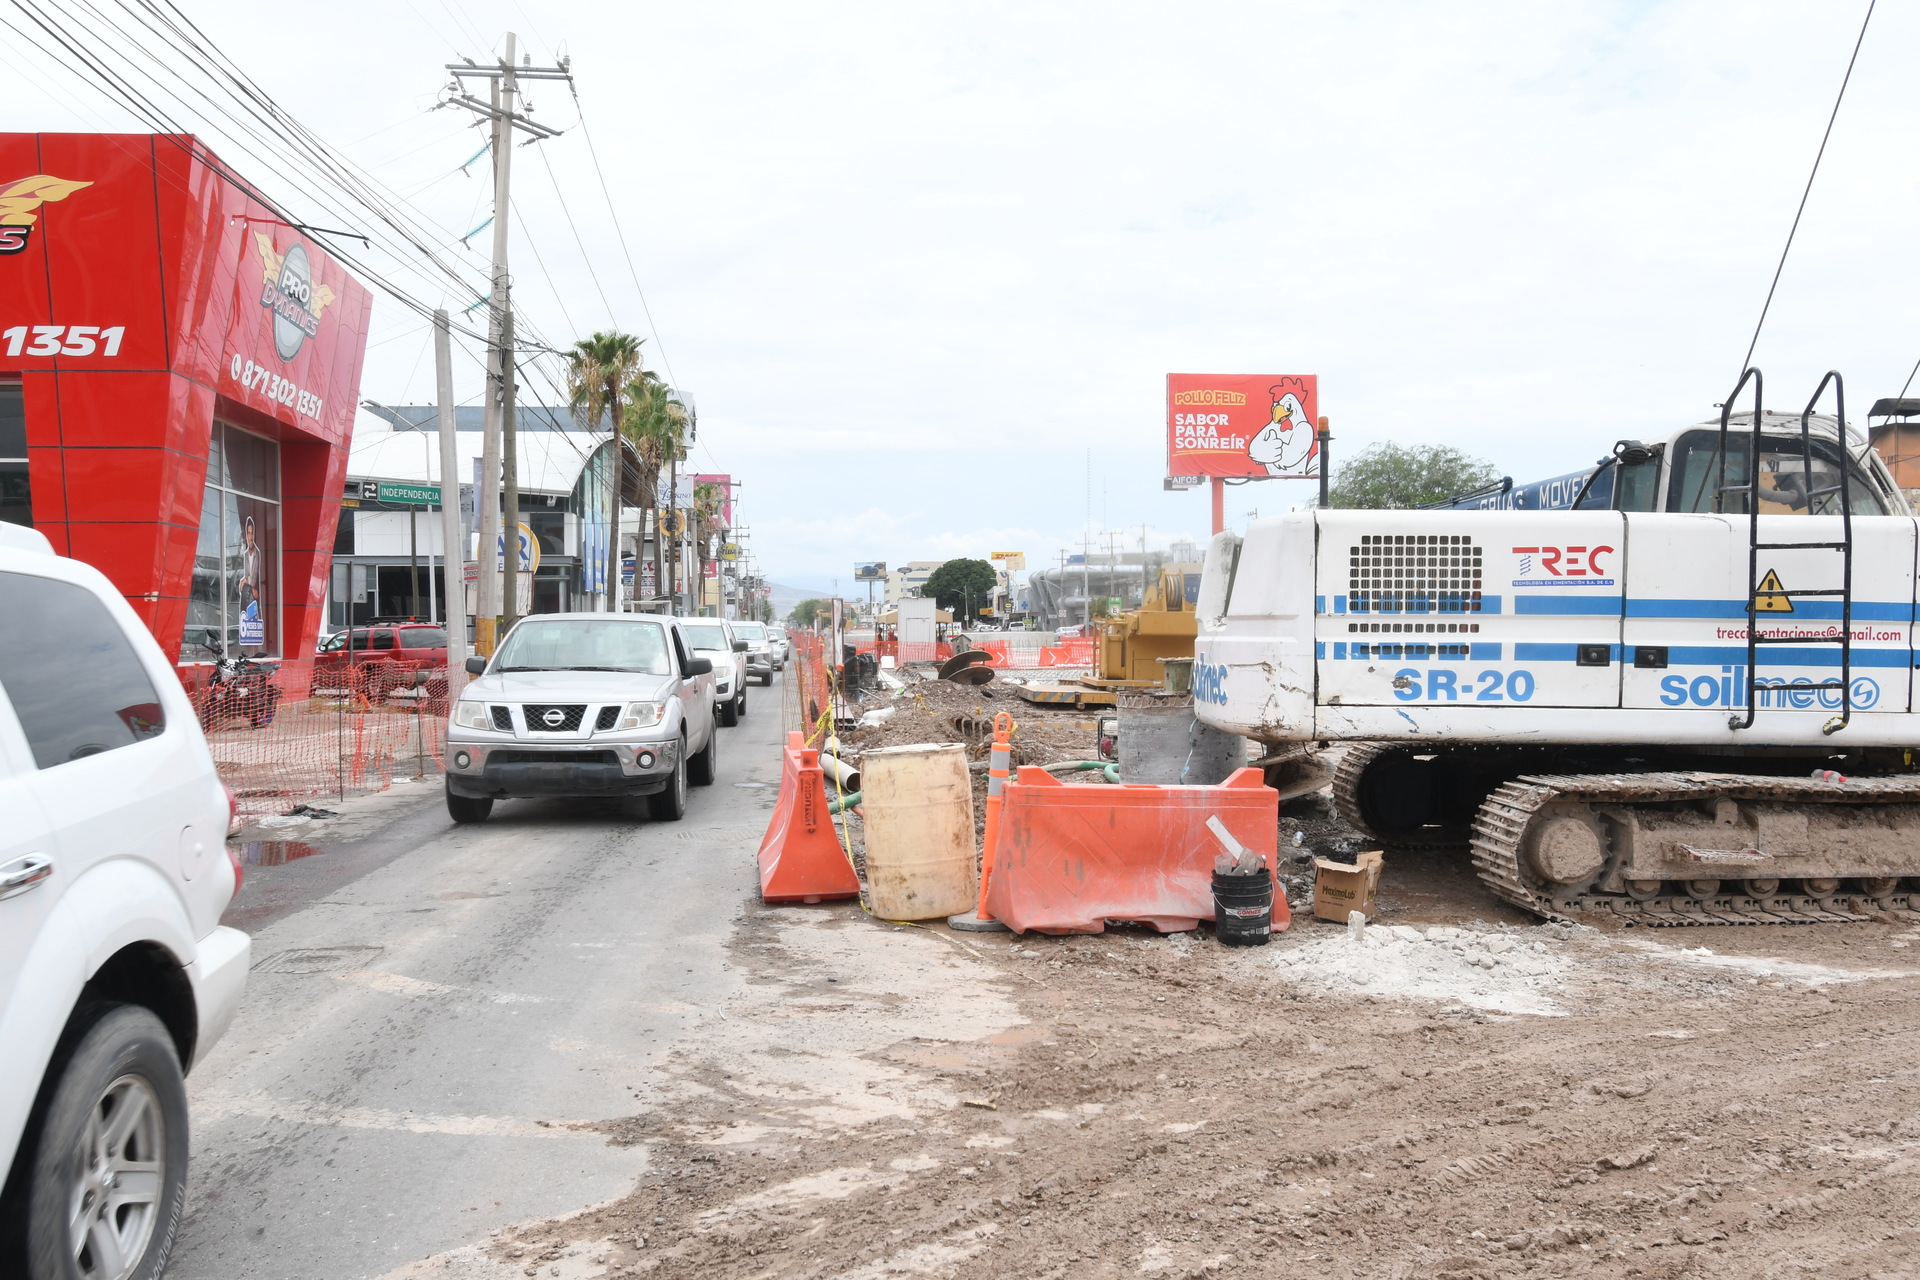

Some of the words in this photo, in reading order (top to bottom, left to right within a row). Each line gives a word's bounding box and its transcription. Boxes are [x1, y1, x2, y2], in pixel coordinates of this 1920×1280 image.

[282, 269, 310, 303] PRO
[262, 283, 319, 337] DYNAMICS
[2, 325, 126, 357] 1351
[241, 360, 270, 395] 871
[268, 374, 296, 408] 302
[296, 389, 323, 421] 1351
[1175, 389, 1213, 405] POLLO
[1214, 390, 1246, 405] FELIZ
[1175, 413, 1229, 425] SABOR
[1175, 426, 1218, 437] PARA
[381, 487, 440, 501] INDEPENDENCIA
[1172, 476, 1198, 484] AIFOS
[1512, 545, 1615, 576] TREC
[1394, 667, 1536, 702] SR-20
